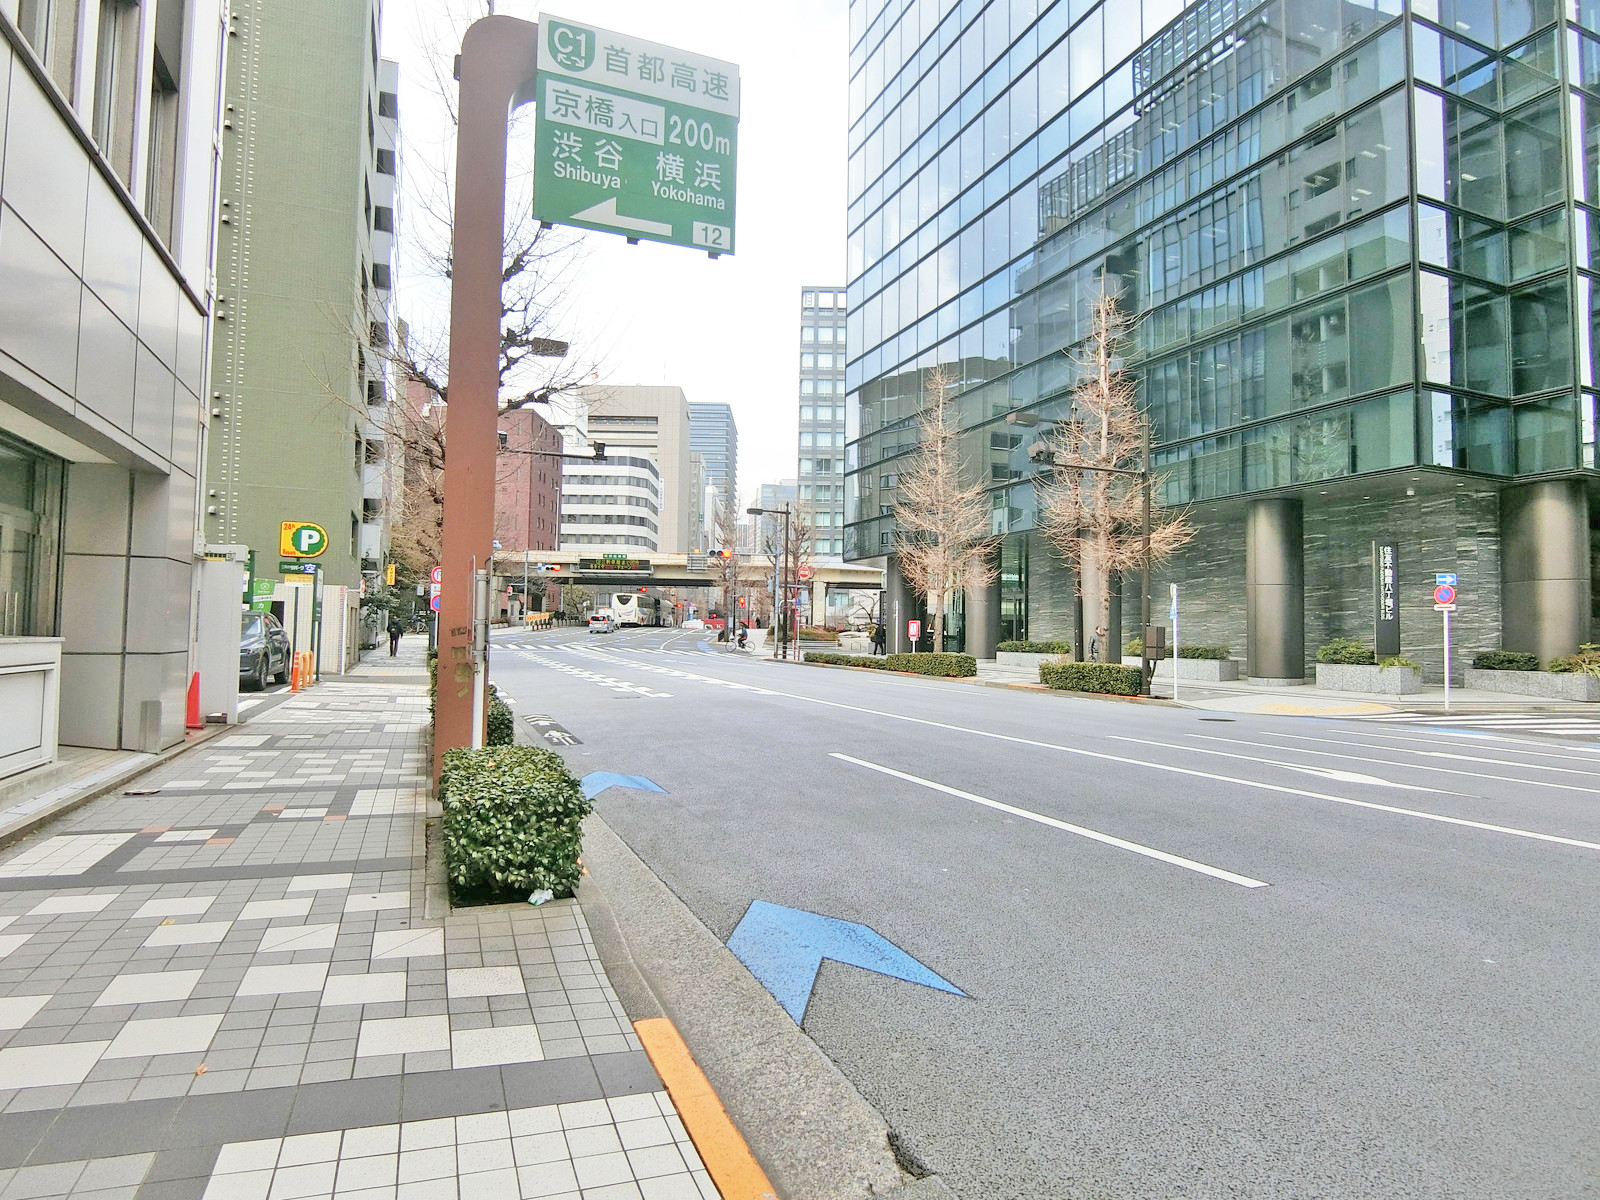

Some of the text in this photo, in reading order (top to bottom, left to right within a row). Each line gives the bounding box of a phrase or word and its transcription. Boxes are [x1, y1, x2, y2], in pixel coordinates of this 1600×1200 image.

[554, 27, 586, 57] C1
[603, 44, 729, 101] 首都高速
[552, 89, 730, 155] 京橋入口 200m
[552, 129, 623, 170] 渋谷
[554, 162, 621, 190] Shibuya
[656, 151, 721, 191] 横浜
[651, 181, 725, 210] Yokohama
[701, 226, 723, 246] 12
[300, 529, 320, 551] P
